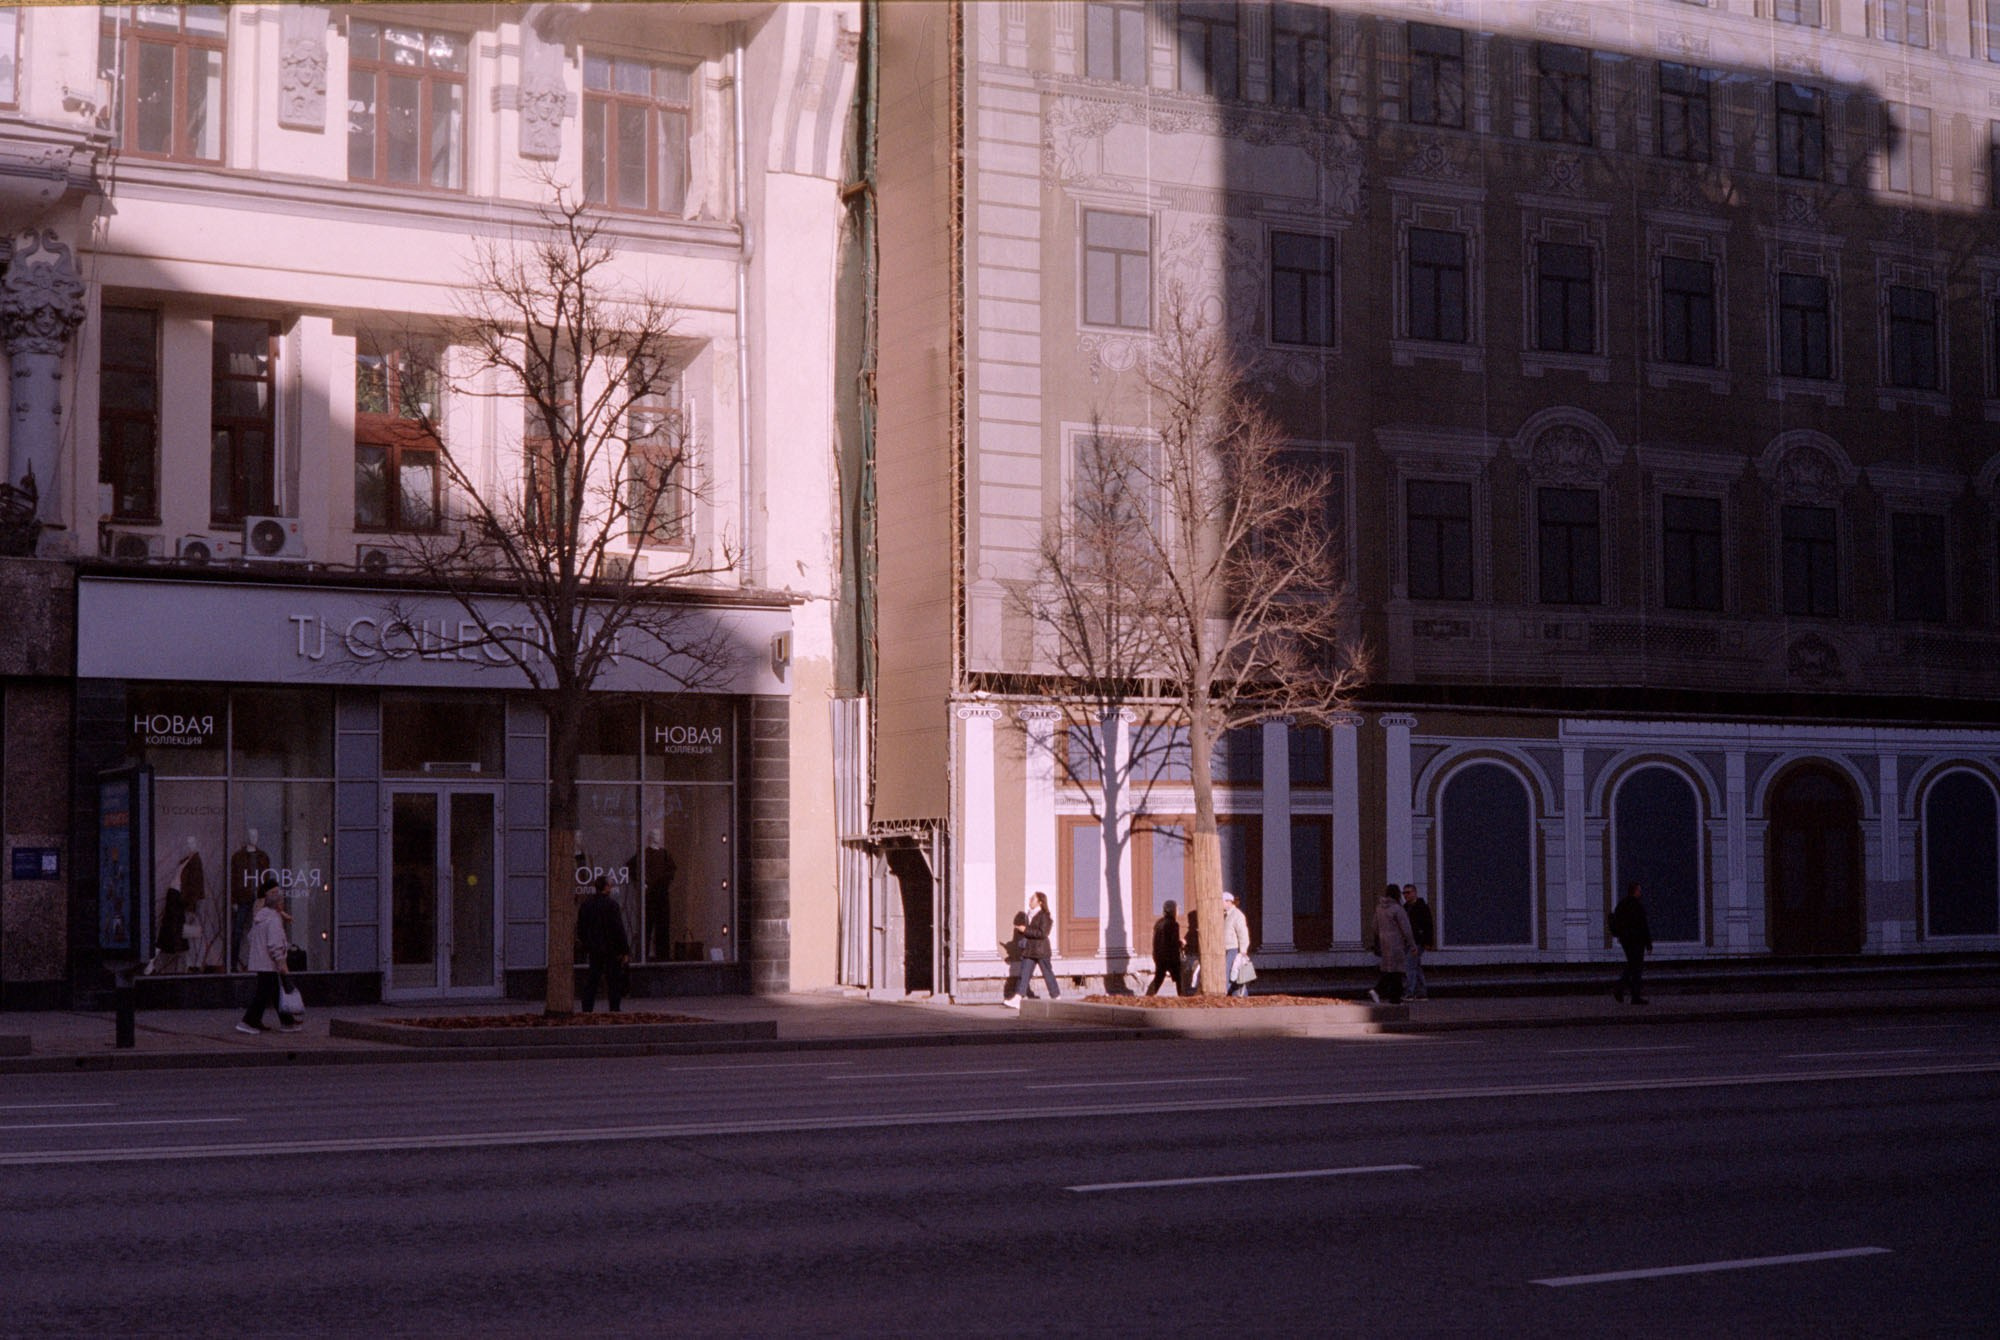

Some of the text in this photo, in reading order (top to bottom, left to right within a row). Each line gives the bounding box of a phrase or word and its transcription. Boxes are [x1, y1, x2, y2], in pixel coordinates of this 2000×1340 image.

[289, 615, 326, 660] TJ
[134, 714, 214, 735] НОВАЯ
[145, 735, 202, 746] КОЛЛЕКЦИЯ
[655, 726, 722, 745] НОВАЯ
[664, 745, 713, 755] КОЛЛЕКЦИЯ
[243, 868, 321, 888] НОВАЯ
[575, 866, 630, 885] ОВАЯ
